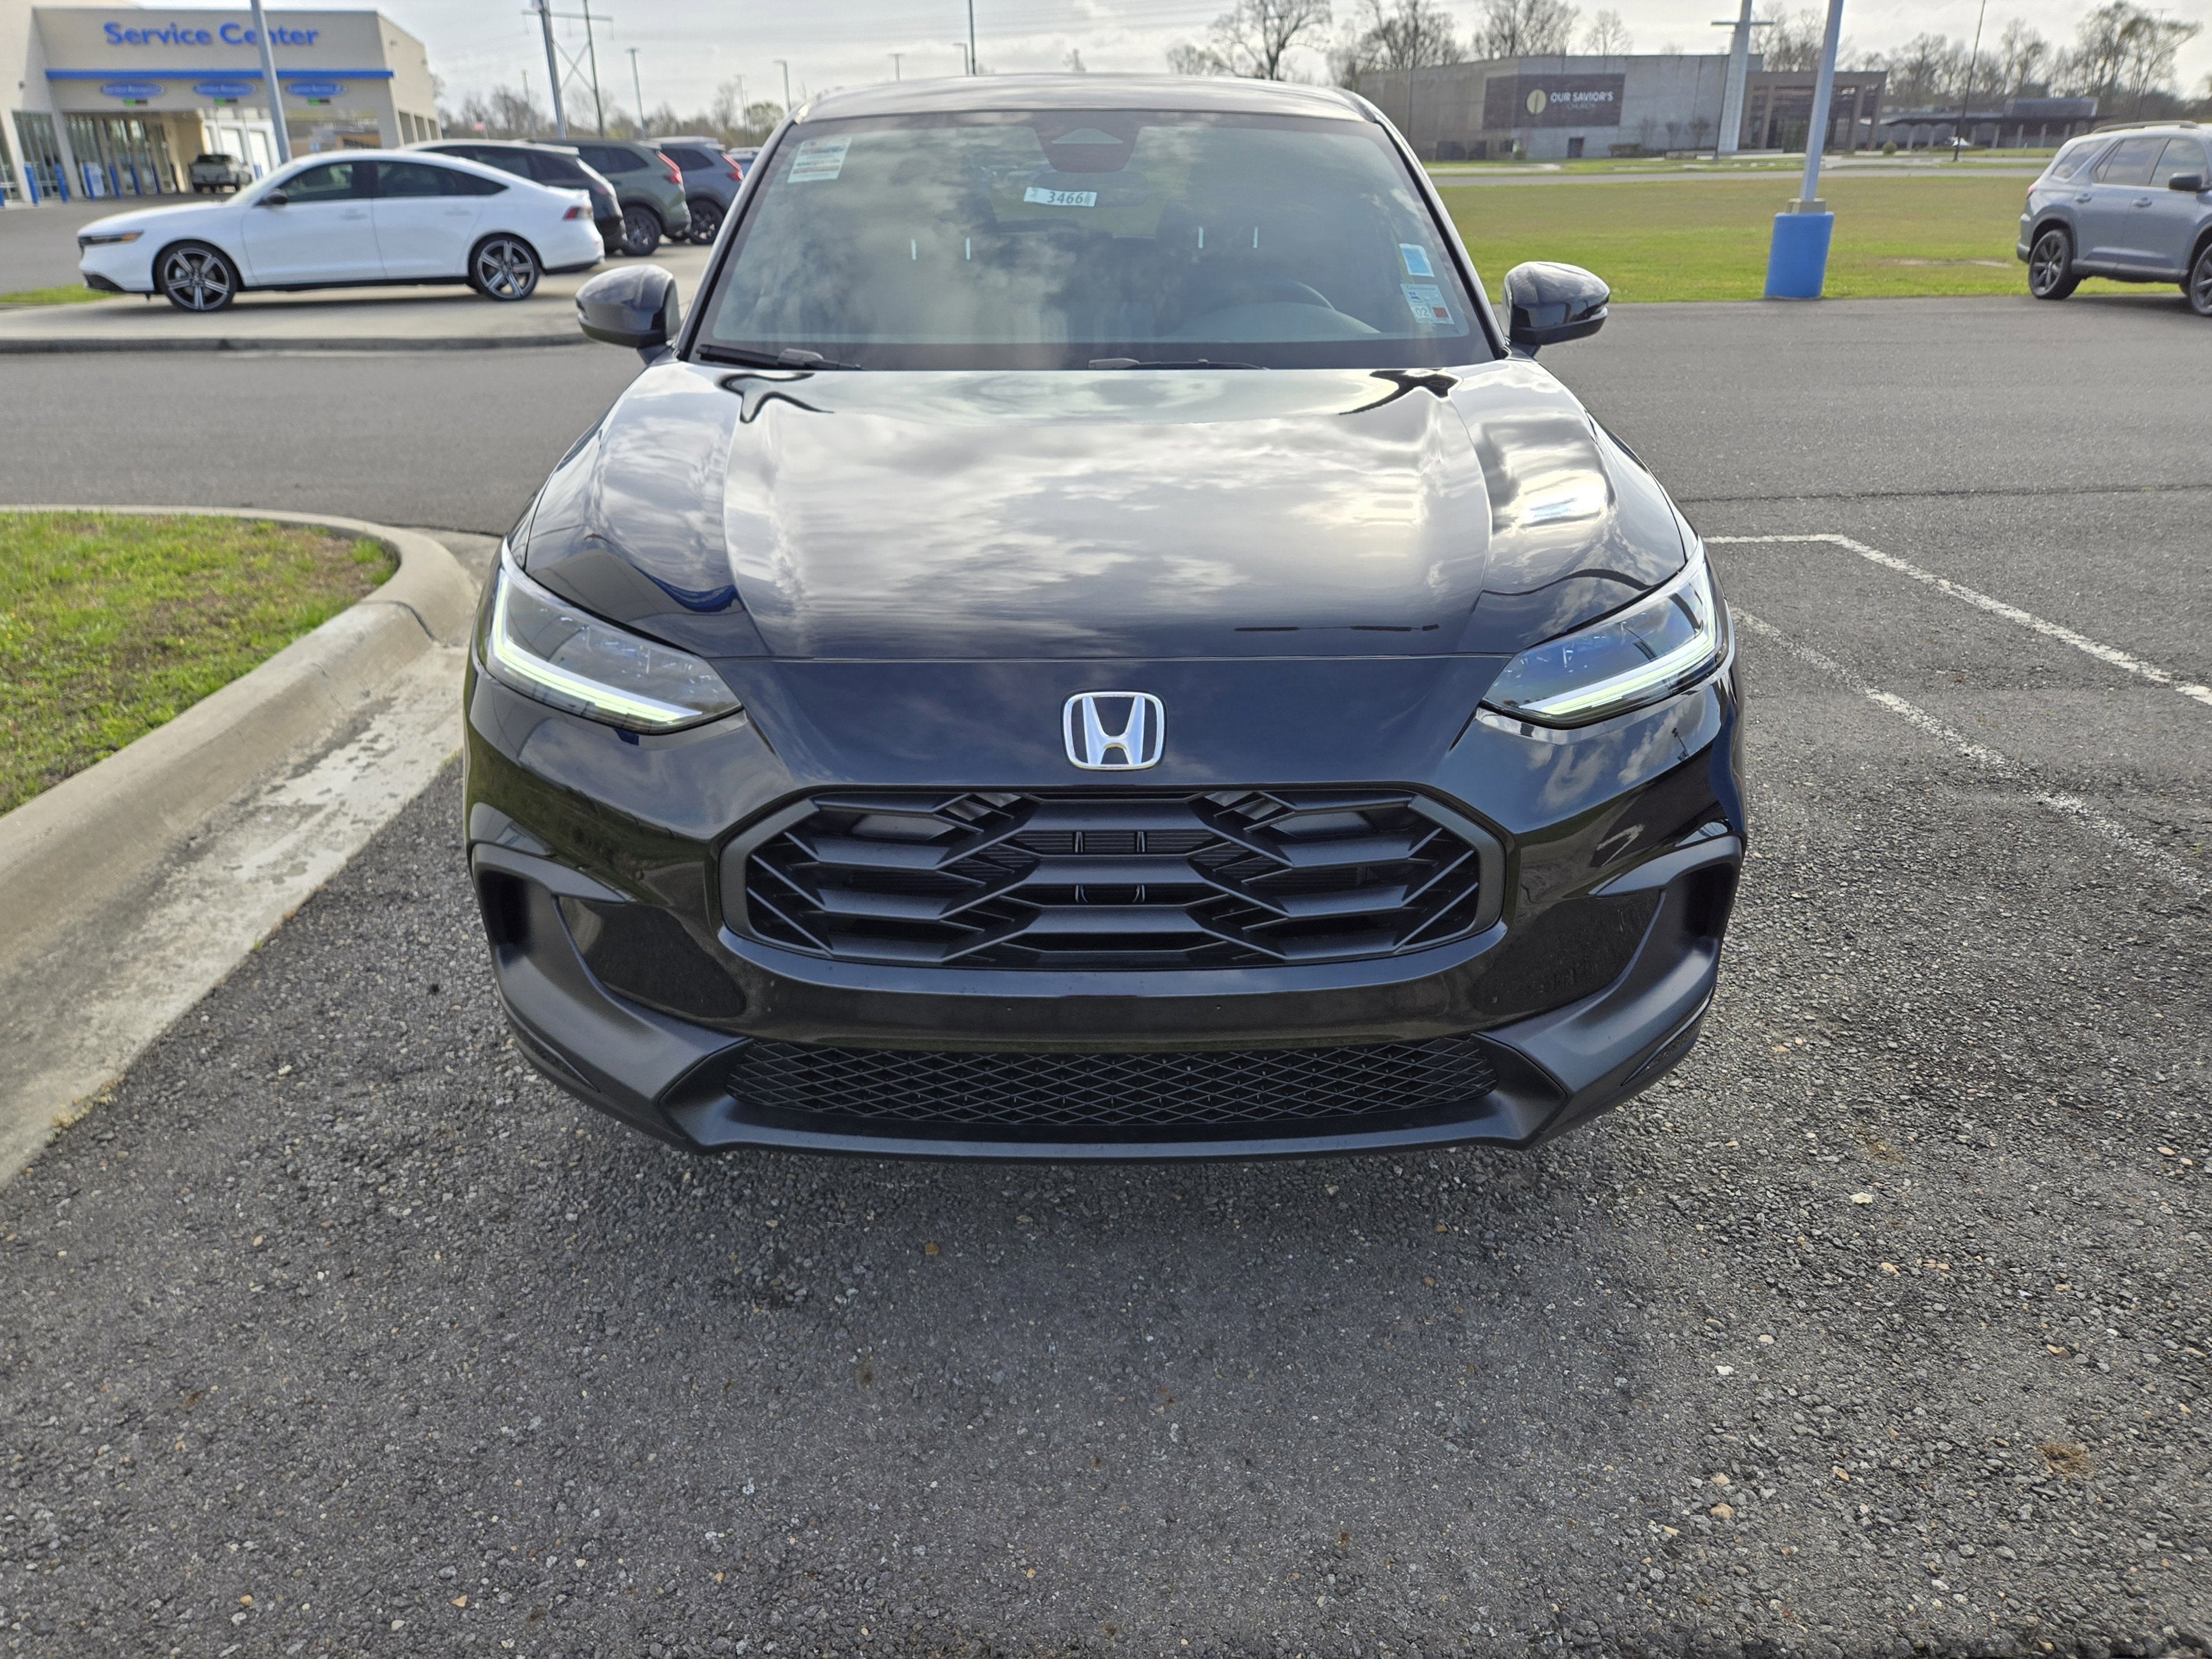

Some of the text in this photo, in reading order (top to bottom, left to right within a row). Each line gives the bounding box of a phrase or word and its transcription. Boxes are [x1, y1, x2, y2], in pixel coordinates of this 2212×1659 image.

[104, 21, 213, 46] Service
[1550, 91, 1614, 103] OUR SAVIOR'S
[1415, 307, 1429, 316] 02
